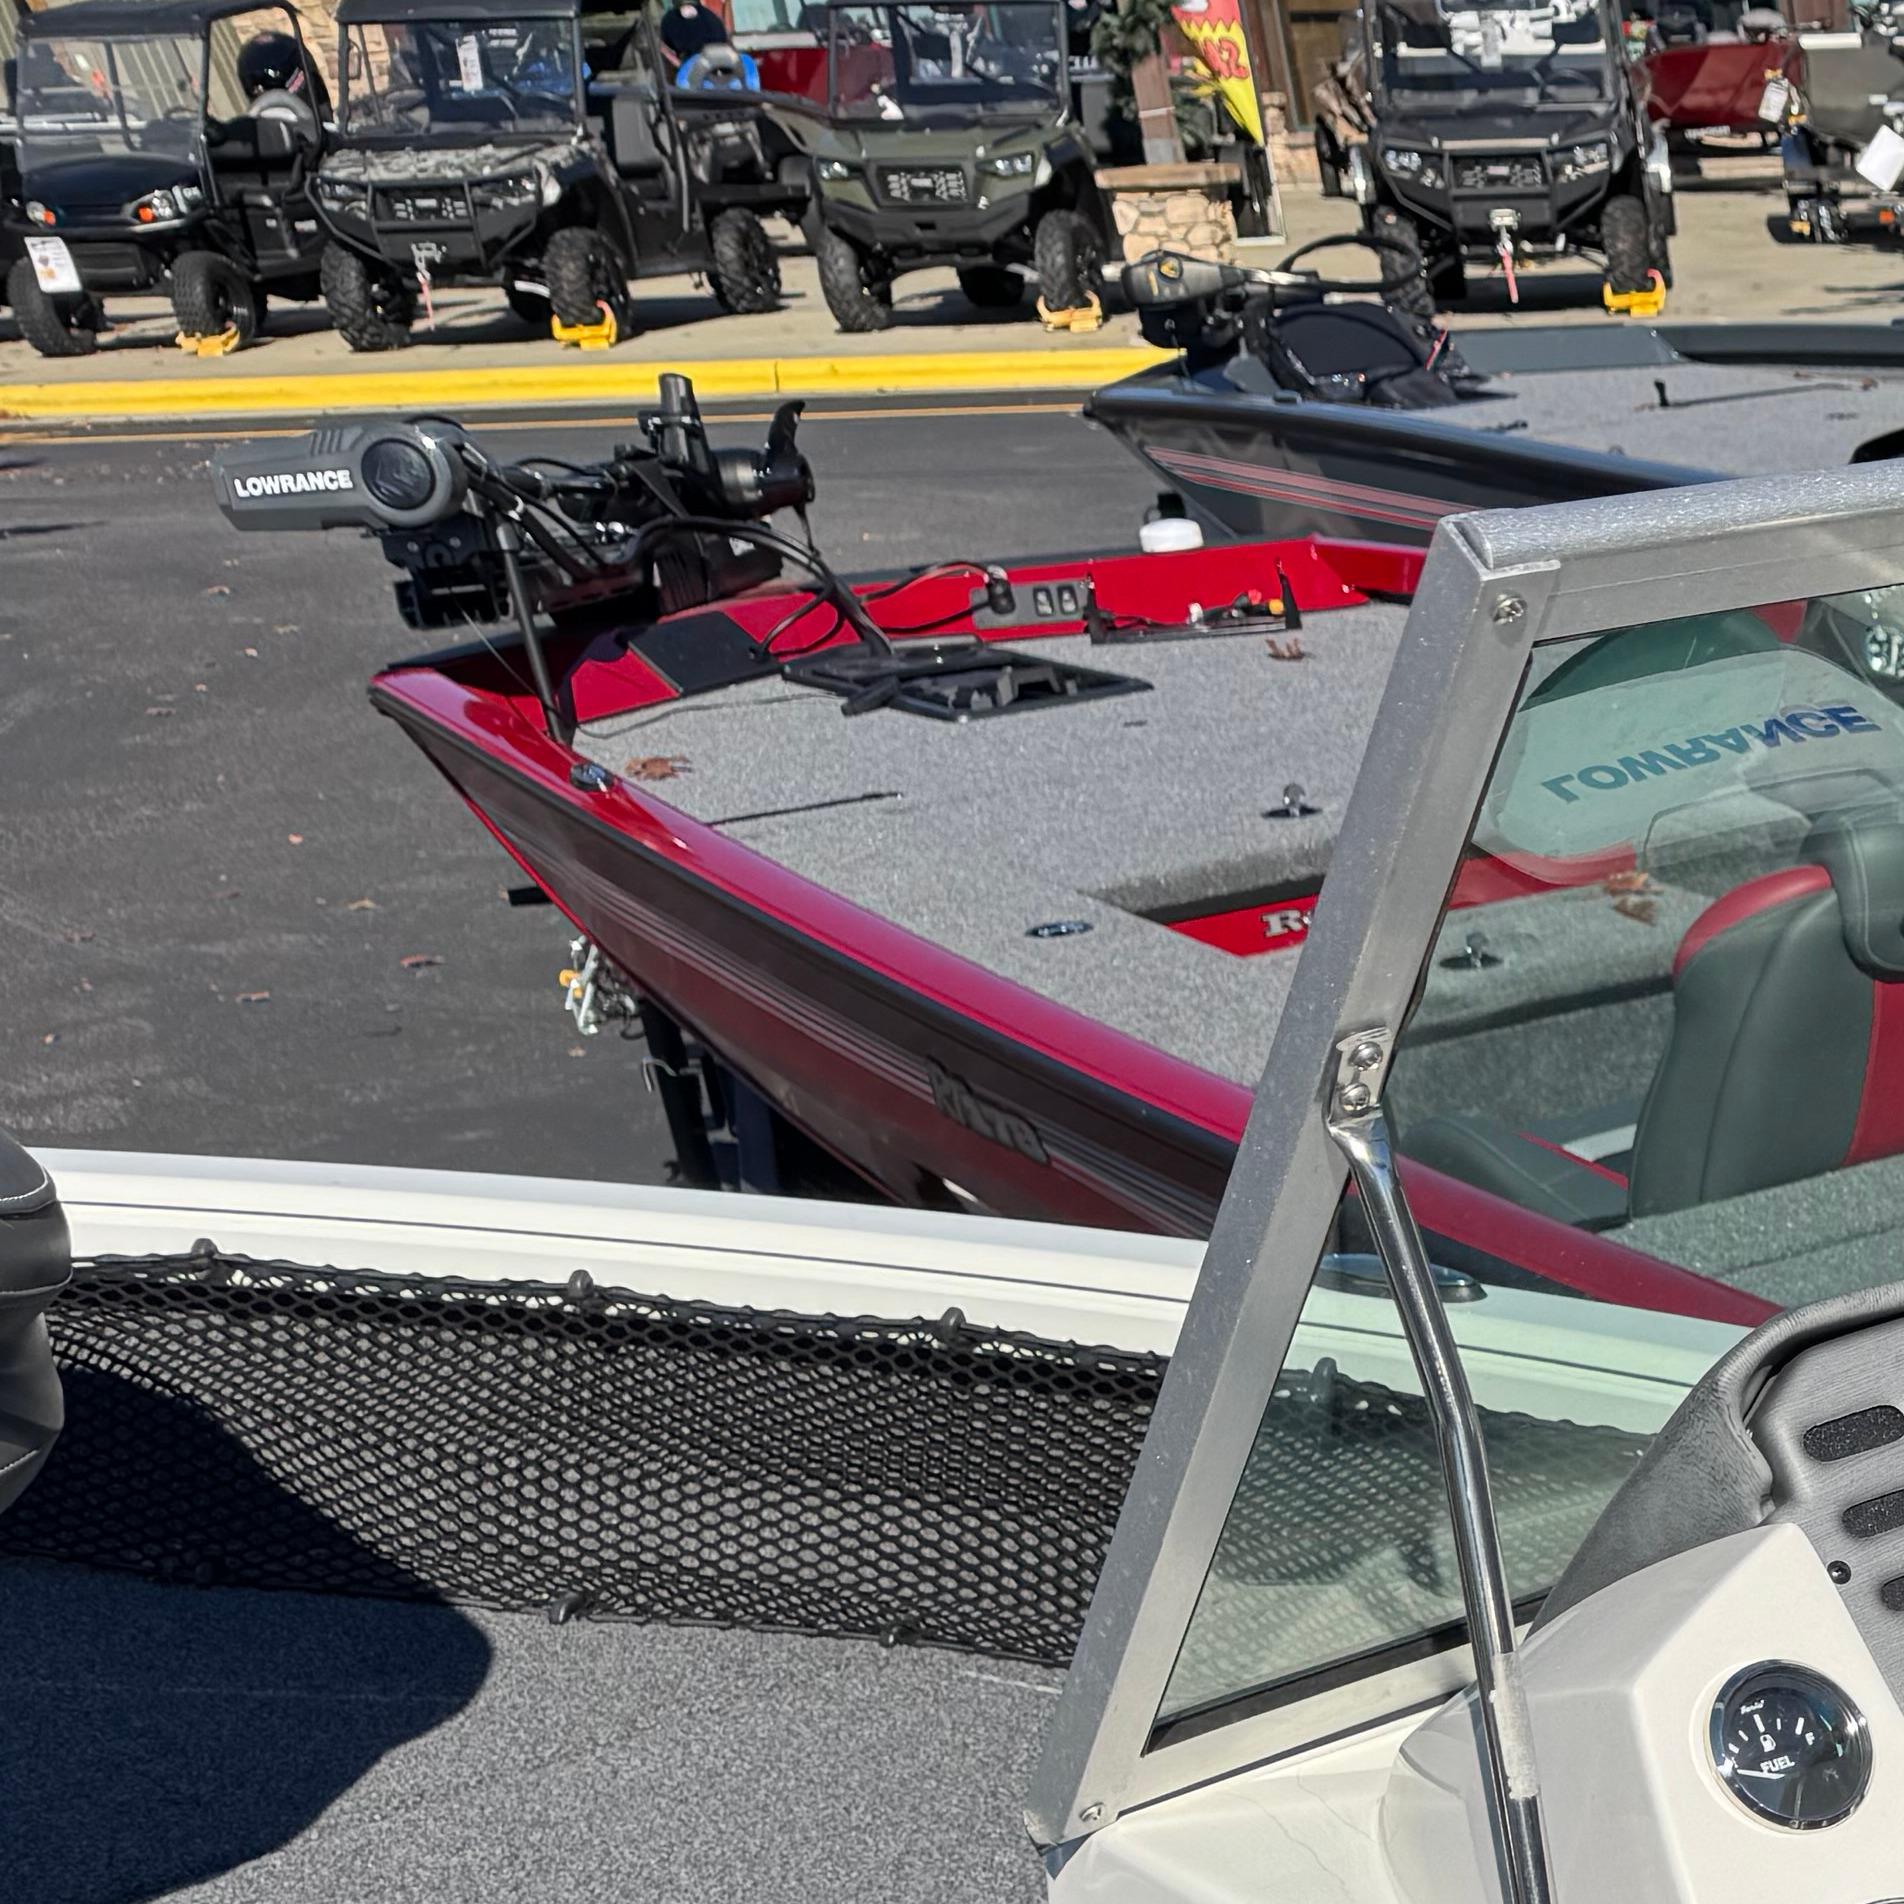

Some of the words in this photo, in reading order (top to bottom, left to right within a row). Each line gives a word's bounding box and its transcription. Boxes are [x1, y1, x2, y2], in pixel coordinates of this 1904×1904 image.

[234, 469, 353, 498] LOWRANCE
[1805, 1732, 1816, 1746] F
[1760, 1755, 1795, 1773] FUEL
